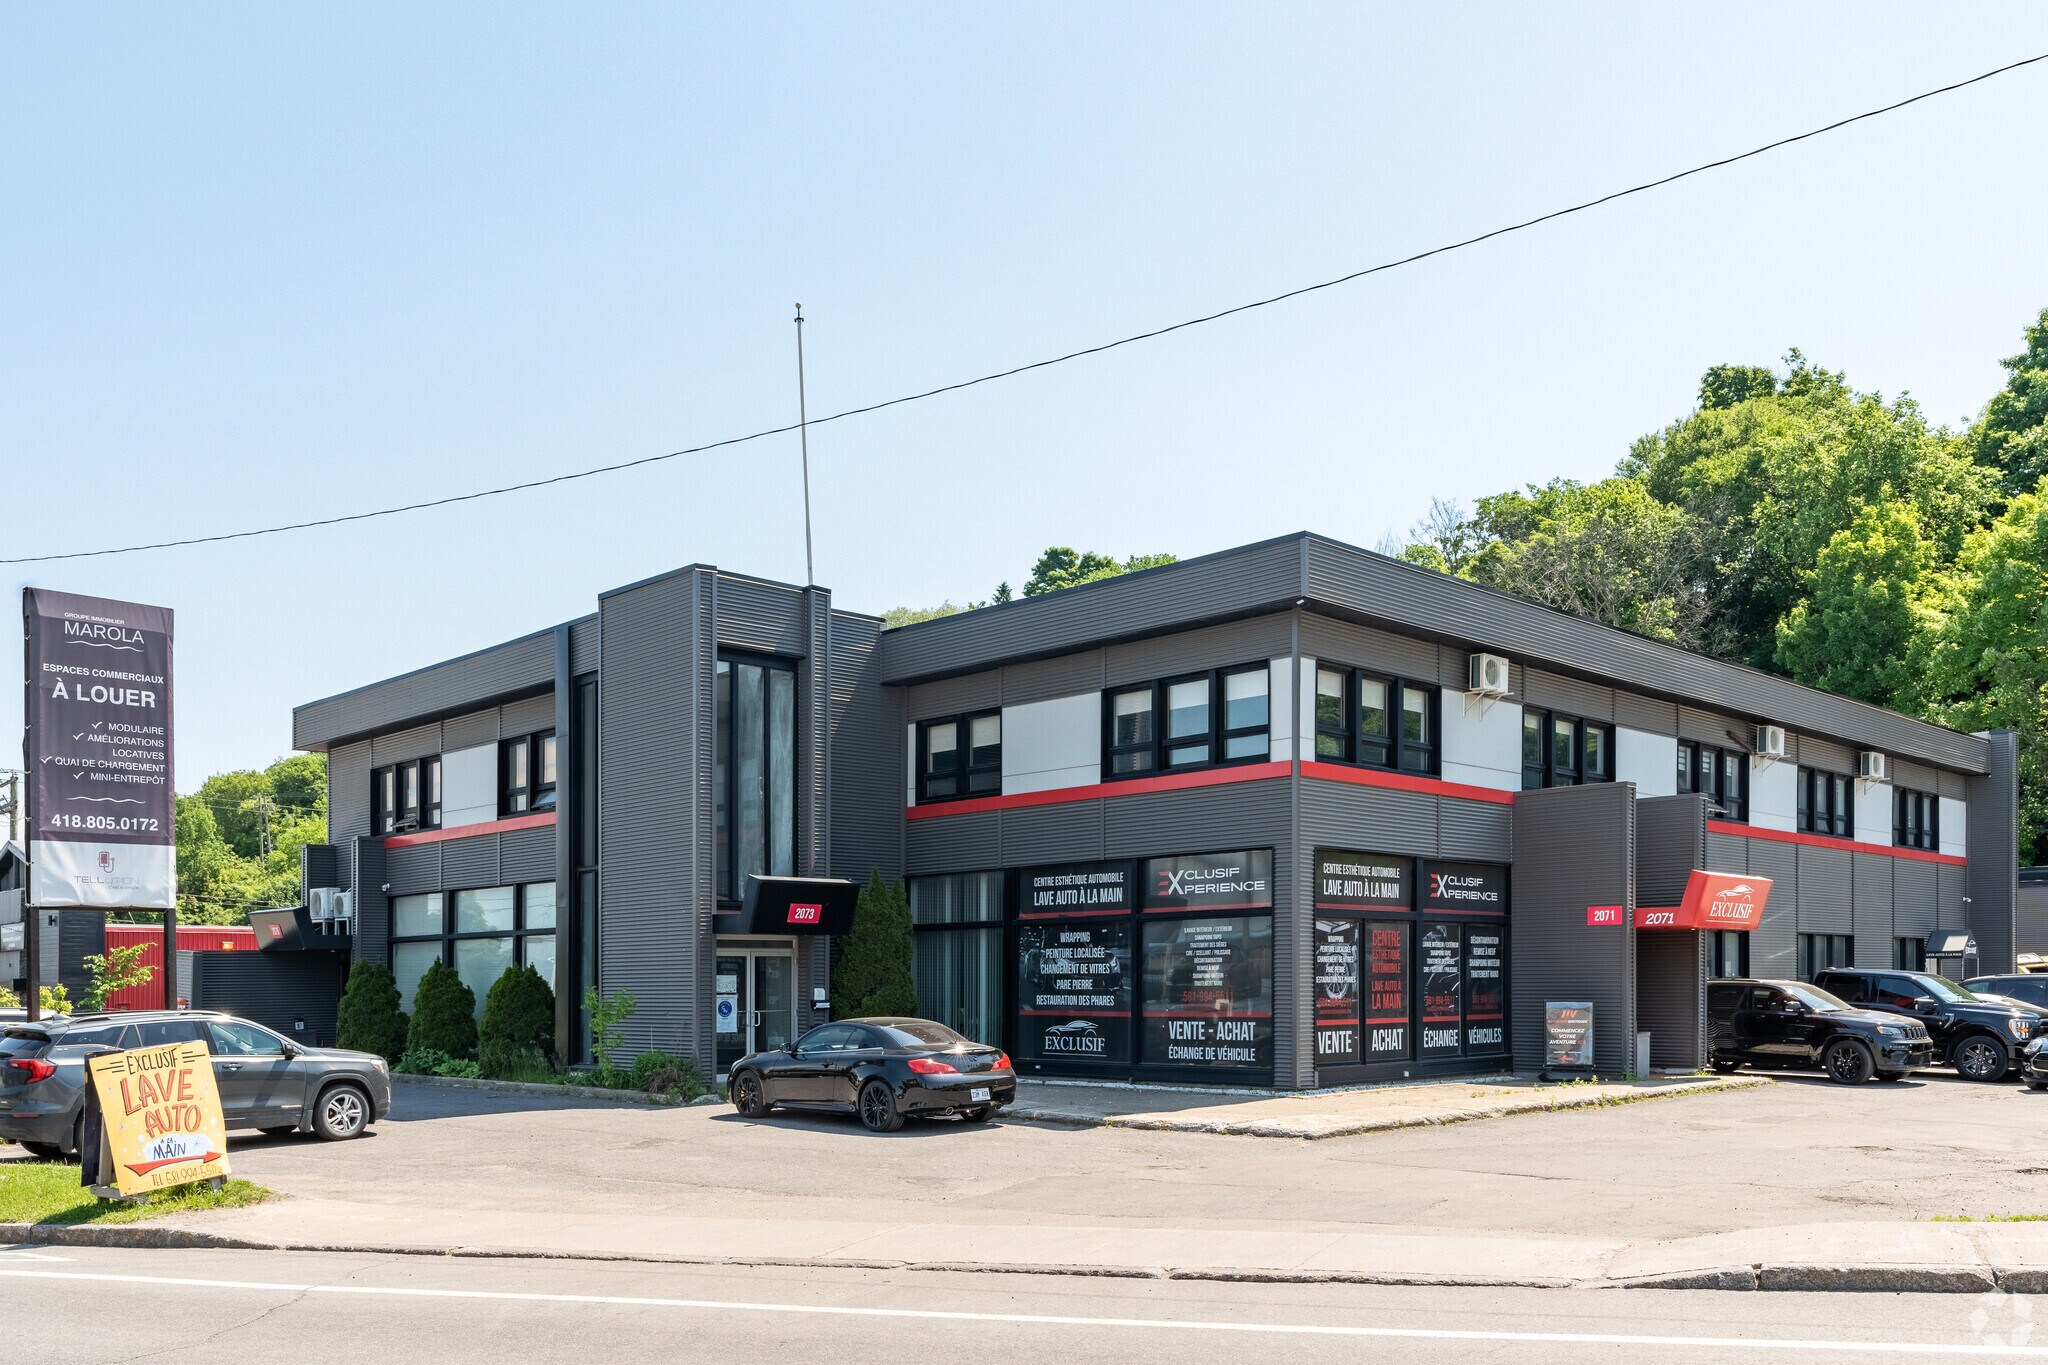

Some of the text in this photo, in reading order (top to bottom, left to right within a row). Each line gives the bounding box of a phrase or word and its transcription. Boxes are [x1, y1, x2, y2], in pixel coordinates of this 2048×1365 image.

[64, 612, 125, 626] GROUPE IMMOBILIER
[64, 620, 144, 644] MAROLA
[43, 663, 164, 685] ESPACES COMMERCIAUX
[51, 677, 156, 708] À LOUER
[108, 722, 164, 735] MODULAIRE
[87, 733, 164, 748] AMÉLIORATIONS
[112, 748, 165, 760] LOCATIVES
[55, 756, 165, 773] QUAI DE CHARGEMENT
[90, 772, 165, 785] MINI-ENTREPÔT
[51, 814, 159, 831] 418.805.0172
[1323, 863, 1400, 879] CENTRE ESTHÉTIQUE AUTOMOBILE
[1034, 872, 1124, 887] CENTRE ESTHÉTIQUE AUTOMOBILE
[1034, 886, 1123, 906] LAVE AUTO À LA MAIN
[1323, 879, 1400, 899] LAVE AUTO À LA MAIN
[795, 907, 815, 919] 2073
[1594, 910, 1615, 922] 2071
[1709, 901, 1754, 919] EXCLUSIF
[1645, 912, 1674, 925] 2071
[1060, 932, 1091, 943] WRAPPING
[1372, 930, 1401, 946] CENTRE
[1045, 945, 1105, 959] PEINTURE LOCALISÉE
[1040, 963, 1111, 974] CHANGEMENT DE VITRES
[1371, 963, 1401, 974] AUTOMOBILE
[1056, 979, 1093, 990] PARE PIERRE
[1371, 980, 1384, 991] LAVE
[1384, 980, 1398, 991] AUTO
[1036, 995, 1115, 1006] RESTAURATION DES PHARES
[1371, 993, 1402, 1009] LA MAIN
[1168, 1021, 1206, 1040] VENTE
[1216, 1021, 1256, 1041] ACHAT
[1423, 1027, 1459, 1048] ÉCHANGE
[1468, 1026, 1502, 1045] VÉHICULES
[1044, 1035, 1106, 1052] EXCLUSIF
[1317, 1031, 1352, 1054] VENTE
[1371, 1028, 1404, 1051] ACHAT
[1168, 1043, 1256, 1062] ÉCHANGE DE VÉHICULE
[126, 1048, 179, 1076] EXCLUSIF
[120, 1069, 194, 1116] LAVE
[145, 1102, 201, 1138] AUTO
[151, 1174, 164, 1187] TEL
